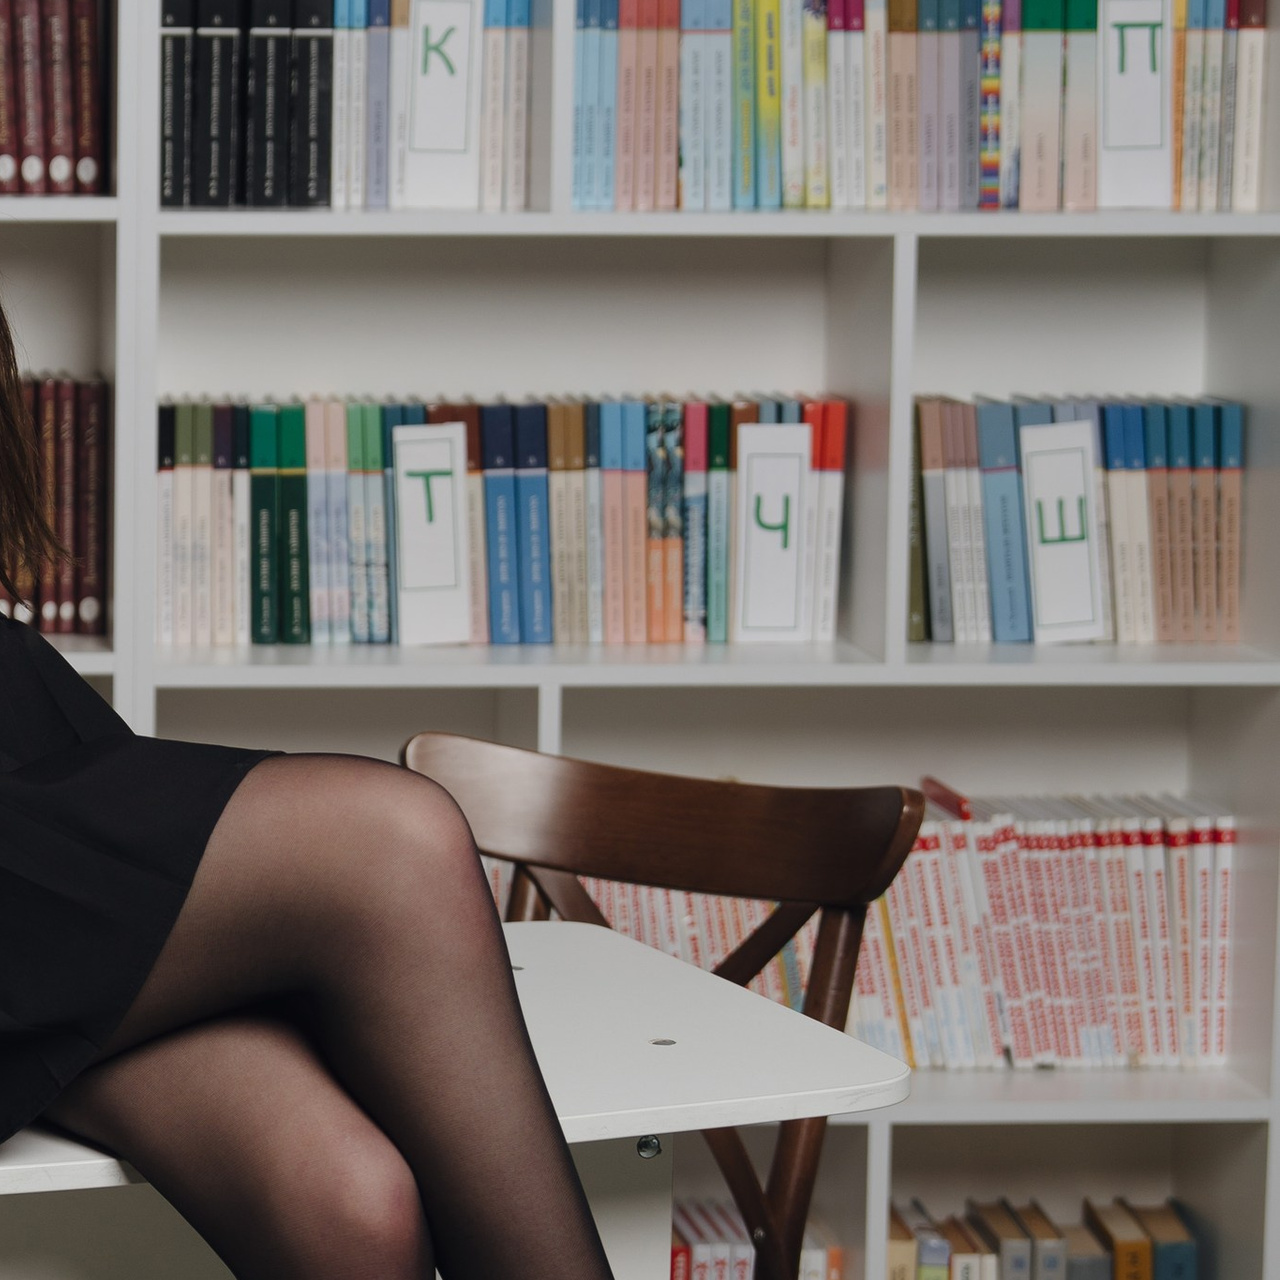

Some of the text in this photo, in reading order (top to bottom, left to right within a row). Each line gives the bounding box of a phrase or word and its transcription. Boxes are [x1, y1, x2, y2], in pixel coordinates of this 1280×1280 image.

[421, 24, 457, 78] К
[1111, 22, 1163, 75] П
[405, 470, 454, 524] Т
[754, 493, 791, 550] Ч
[1036, 494, 1090, 546] Ш
